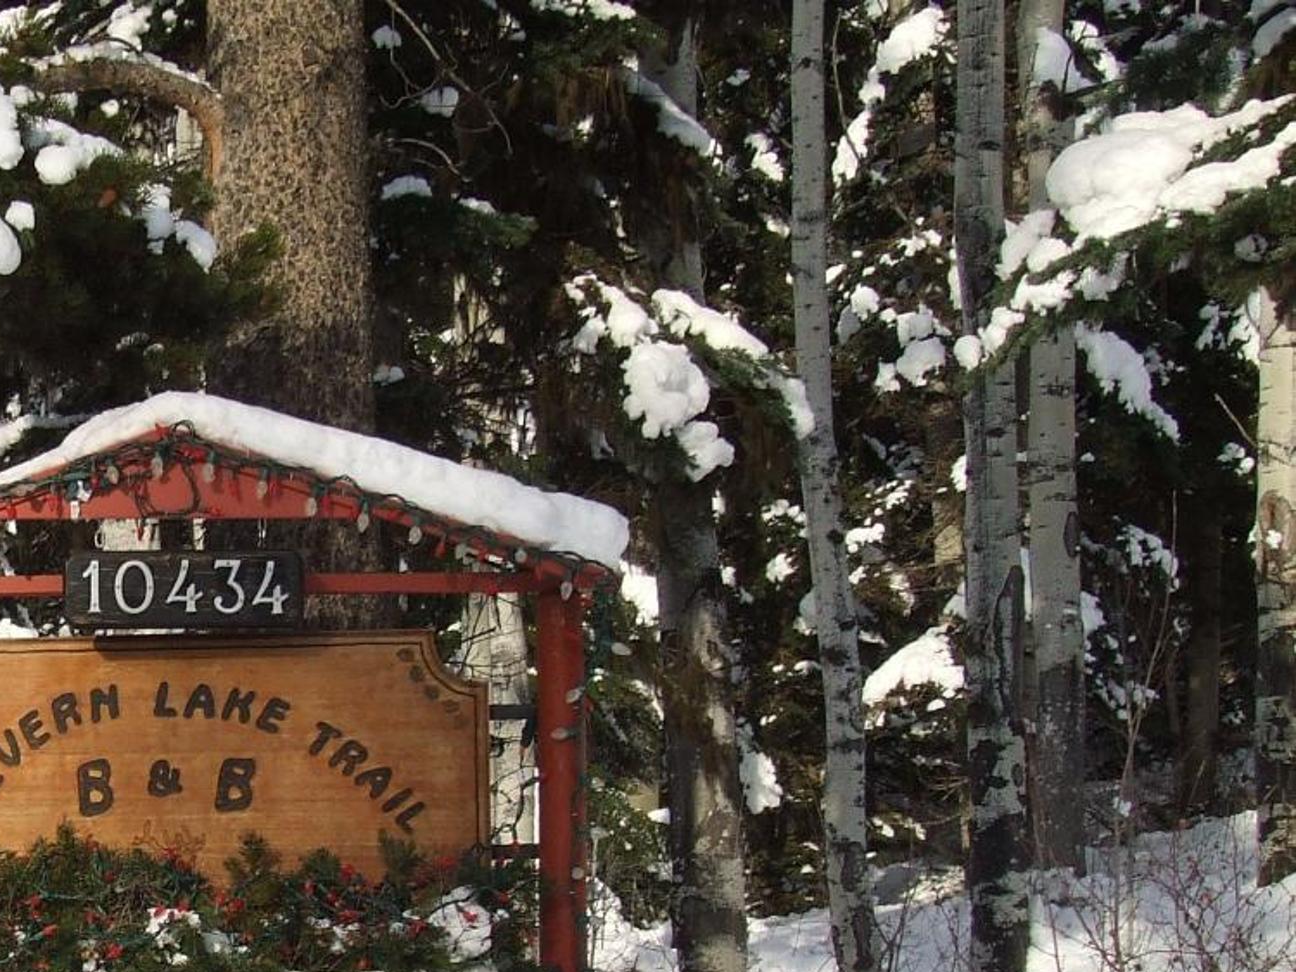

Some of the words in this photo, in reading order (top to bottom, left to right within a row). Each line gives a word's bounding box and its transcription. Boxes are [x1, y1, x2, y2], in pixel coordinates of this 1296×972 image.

[82, 559, 289, 614] 10434
[153, 681, 291, 734] LAKE
[308, 721, 426, 834] TRAIL
[77, 758, 114, 817] B
[147, 759, 183, 797] &
[215, 758, 256, 812] B
